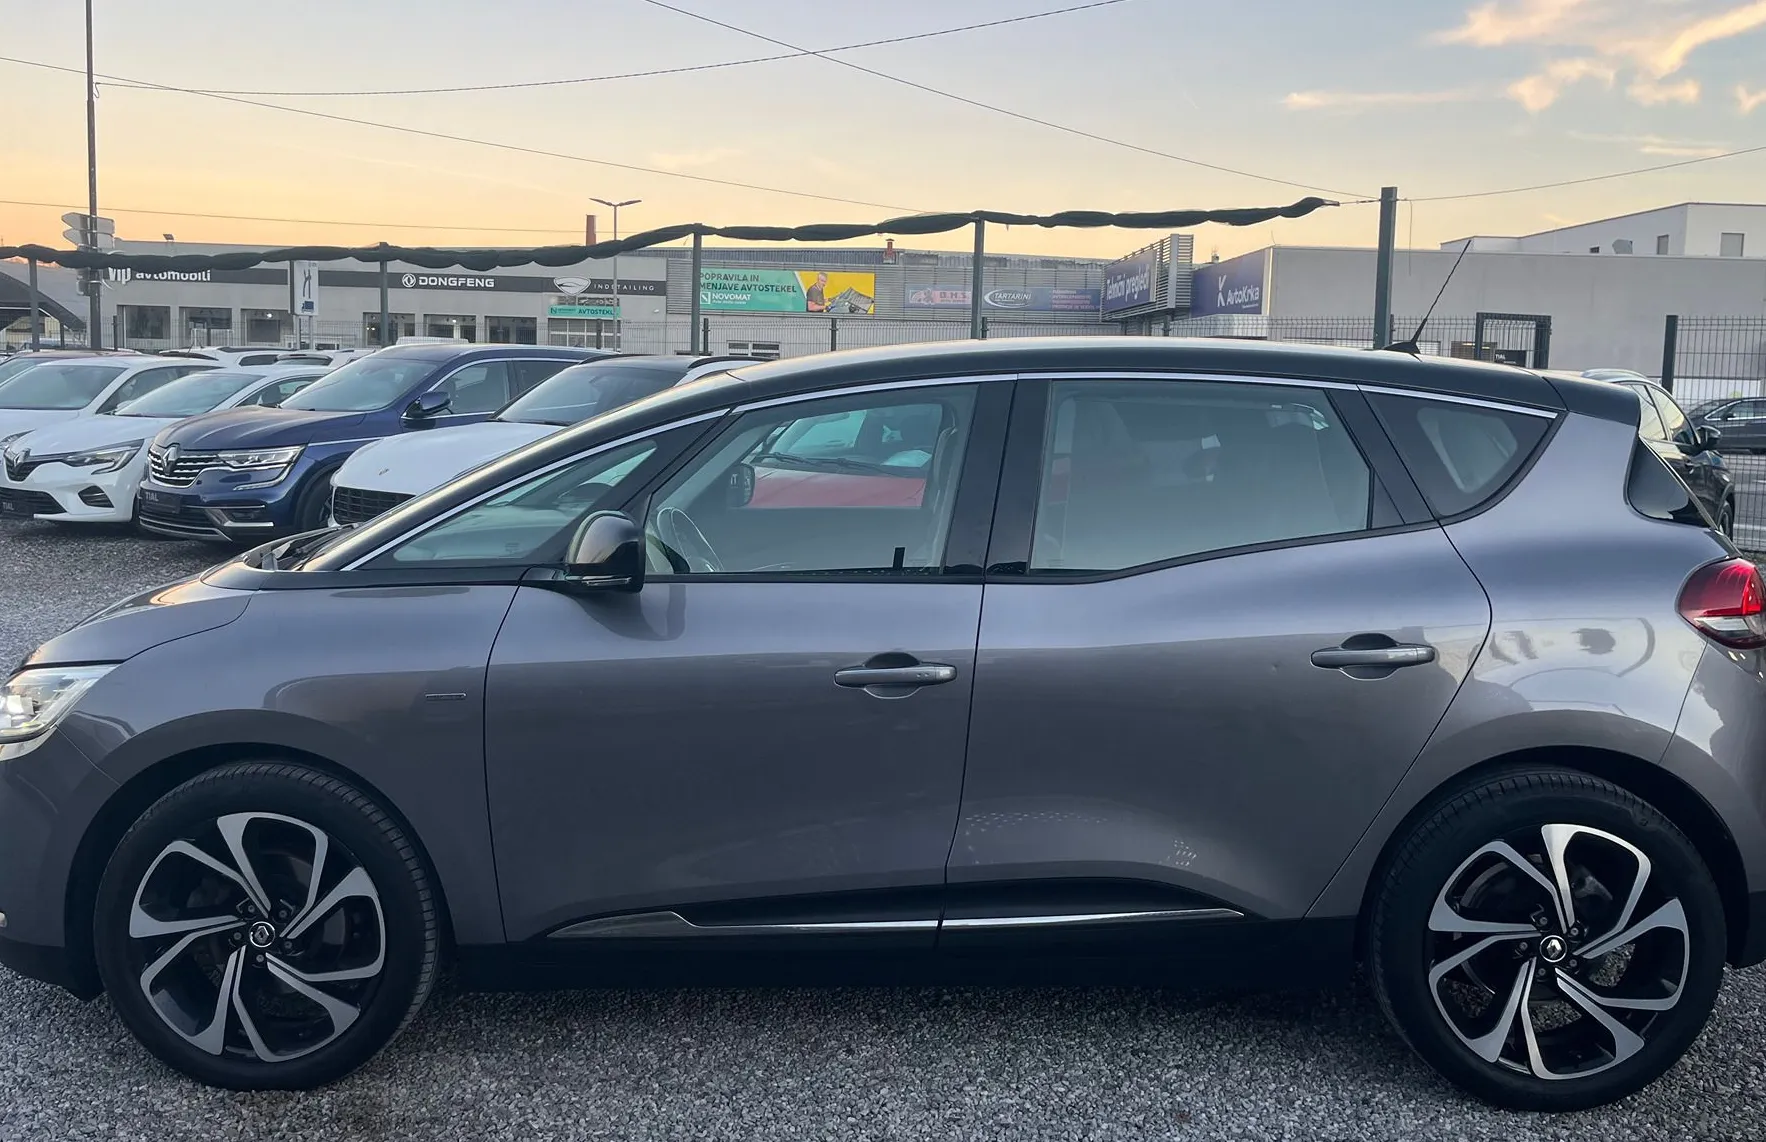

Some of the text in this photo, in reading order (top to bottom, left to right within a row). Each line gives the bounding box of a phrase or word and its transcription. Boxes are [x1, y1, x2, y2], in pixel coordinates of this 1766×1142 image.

[700, 272, 760, 282] POPRAVILA IN
[418, 276, 495, 288] DONGFENG
[740, 283, 797, 293] AVTOSTEKEL
[712, 292, 751, 301] NOVOMAT
[993, 292, 1032, 300] TARTARINI
[578, 308, 618, 316] AVTOSTEKL
